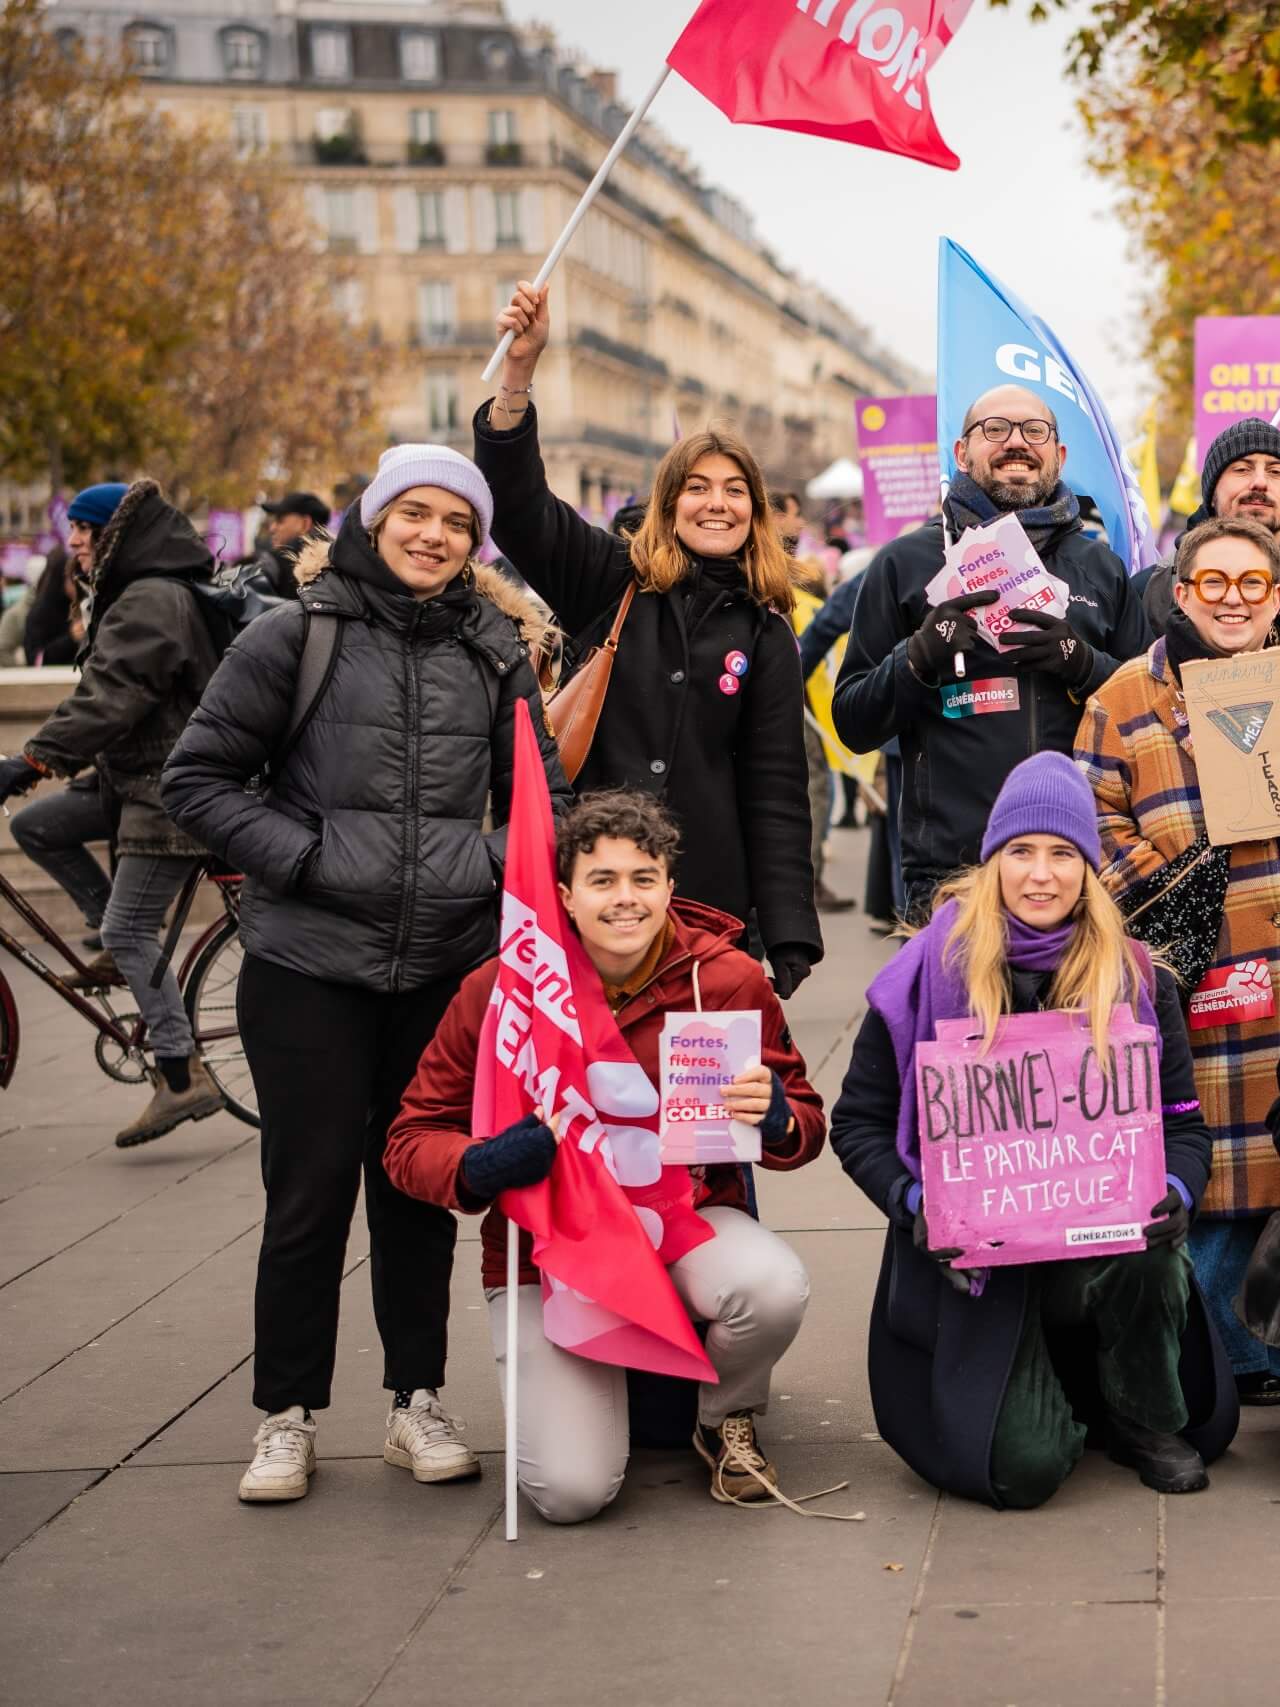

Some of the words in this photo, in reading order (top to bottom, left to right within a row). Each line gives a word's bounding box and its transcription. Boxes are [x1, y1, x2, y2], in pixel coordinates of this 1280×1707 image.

[1211, 363, 1250, 387] ON
[958, 549, 1005, 577] Fortes,
[967, 566, 1009, 592] fières,
[985, 611, 997, 622] et
[998, 604, 1010, 617] en
[990, 594, 1047, 634] CORE
[1241, 715, 1265, 748] MEN
[1204, 988, 1229, 1001] jeunes
[670, 1036, 728, 1051] Fortes,
[669, 1054, 721, 1069] fières,
[668, 1072, 735, 1086] féminist
[667, 1097, 680, 1106] et
[685, 1097, 700, 1106] en
[667, 1103, 735, 1122] COLÈR
[942, 1148, 974, 1183] LE
